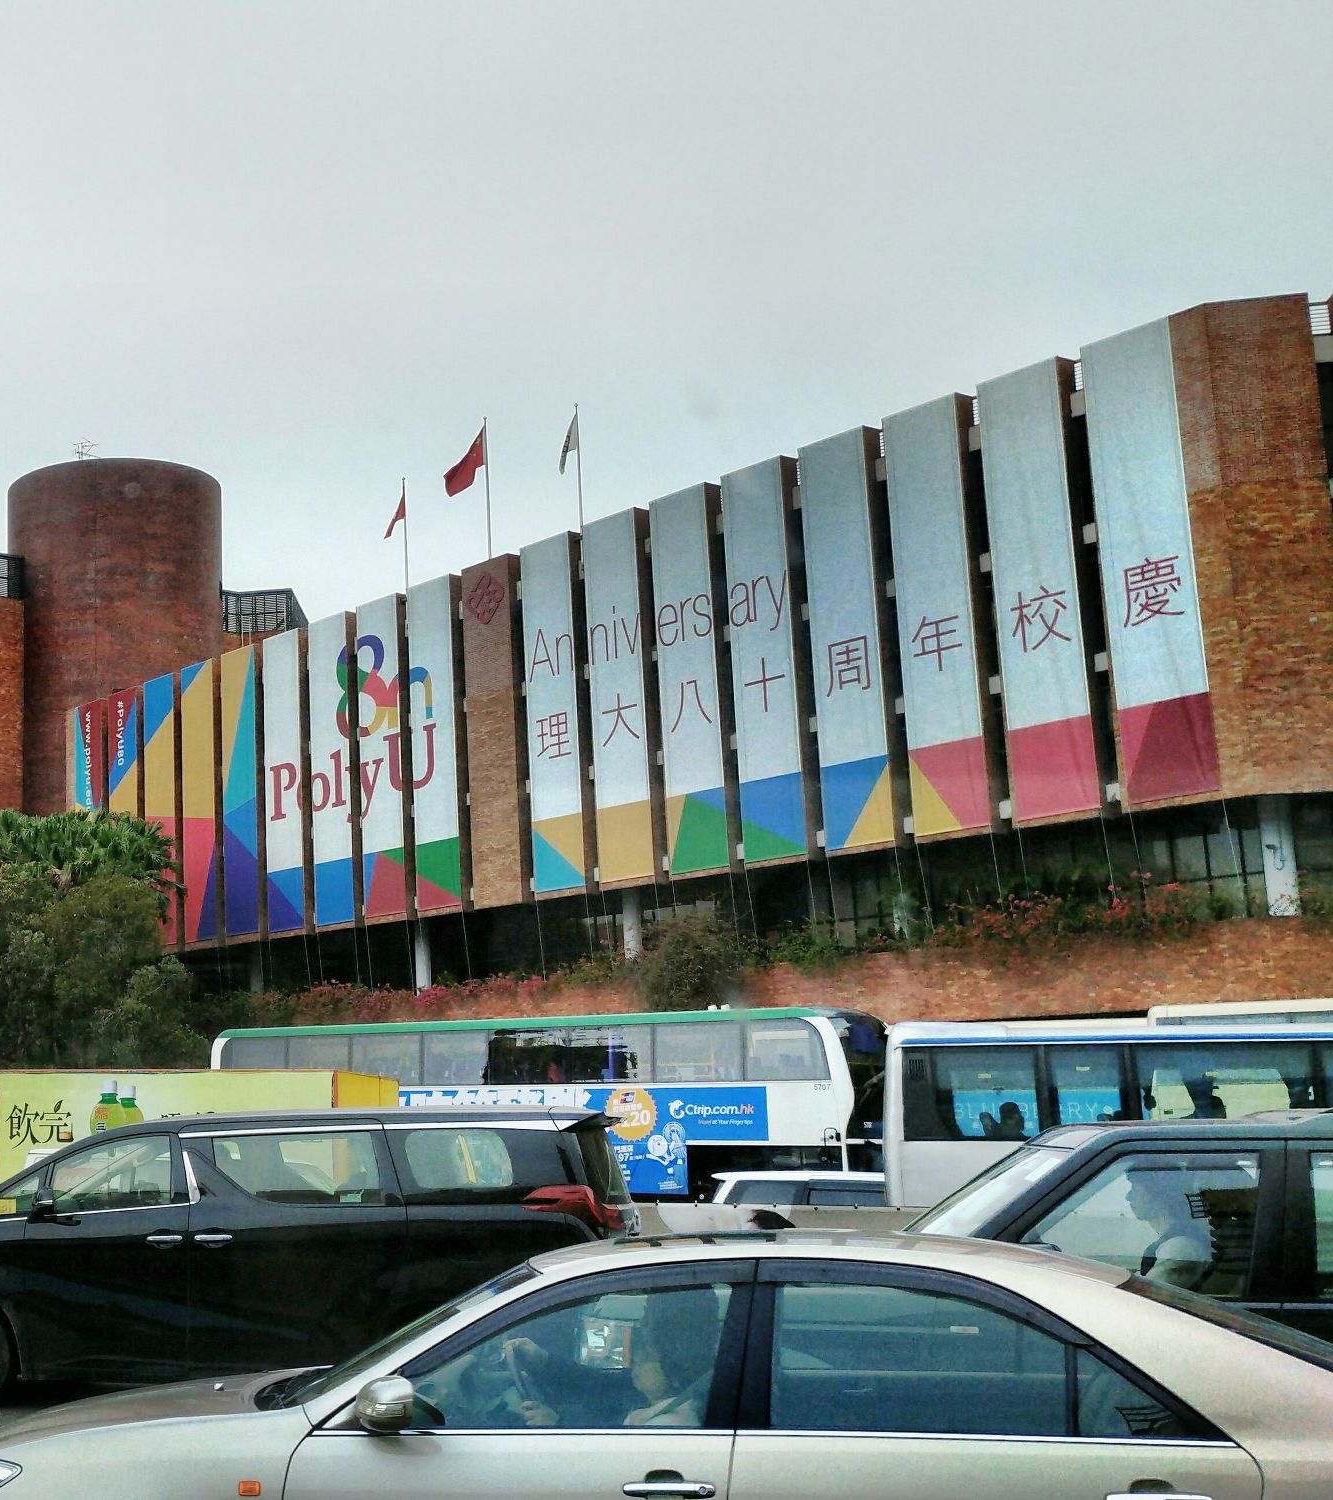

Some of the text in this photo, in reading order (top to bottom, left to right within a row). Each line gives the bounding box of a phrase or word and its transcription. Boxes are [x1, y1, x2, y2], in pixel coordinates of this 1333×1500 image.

[529, 569, 787, 683] Anniversary
[535, 554, 1186, 760] 理大八十周年校慶
[83, 711, 94, 812] www.polyu.ed
[116, 700, 126, 767] #PolyU80
[269, 722, 437, 825] PolyU
[684, 1103, 755, 1118] Ctrip.com.hk
[813, 1083, 831, 1091] 5707
[954, 1101, 1098, 1124] BLUBRY
[6, 1099, 74, 1150] 飲完
